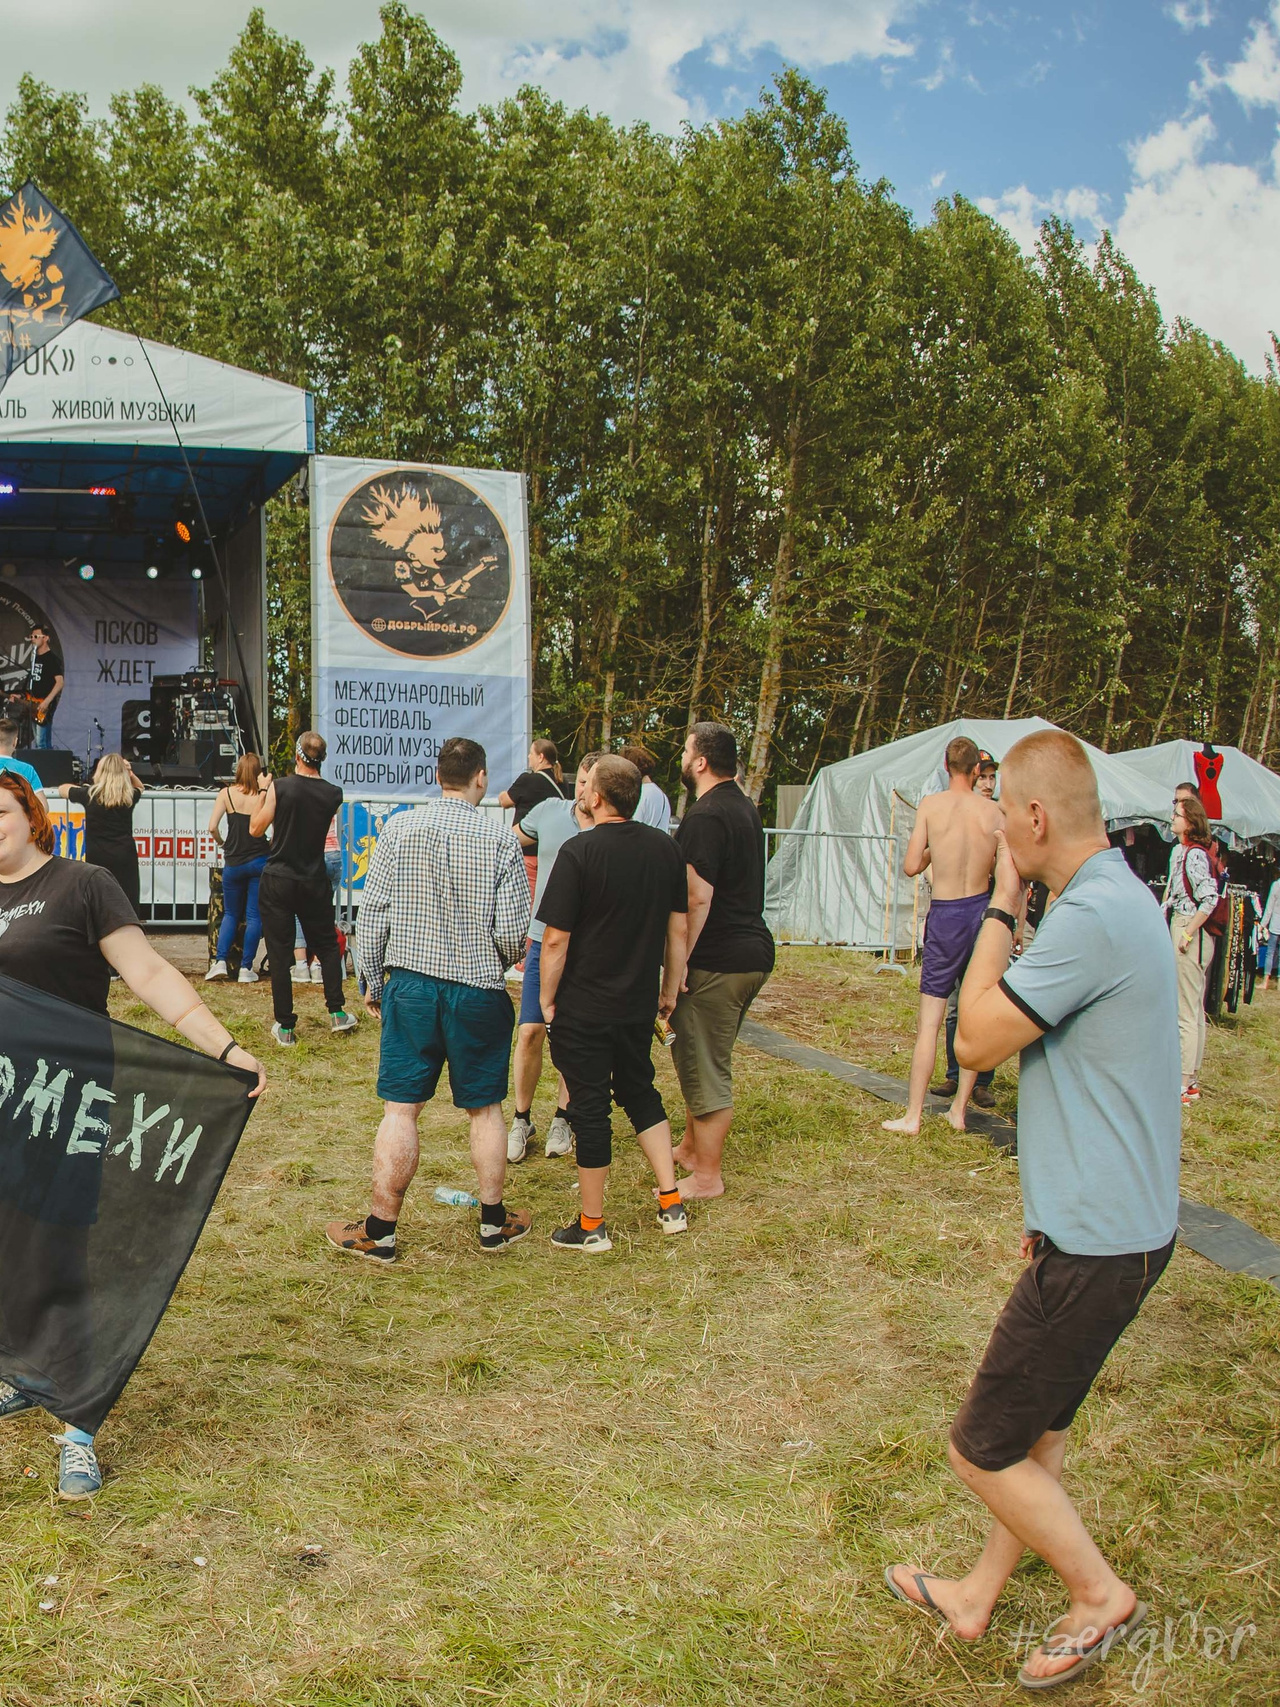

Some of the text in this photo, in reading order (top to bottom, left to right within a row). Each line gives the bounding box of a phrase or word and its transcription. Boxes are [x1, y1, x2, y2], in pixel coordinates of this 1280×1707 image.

[51, 397, 115, 420] ЖИВОЙ
[120, 401, 197, 424] МУЗЫКИ
[94, 619, 159, 646] ПСКОВ
[387, 619, 478, 636] ДОБРЫЙРОК.РФ
[96, 659, 157, 687] ЖДЕТ
[334, 680, 484, 708] МЕЖДУНАРОДНЫЙ
[334, 707, 432, 731] ФЕСТИВАЛЬ
[335, 732, 394, 756] ЖИВОЙ
[334, 761, 411, 785] «ДОБРЫЙ
